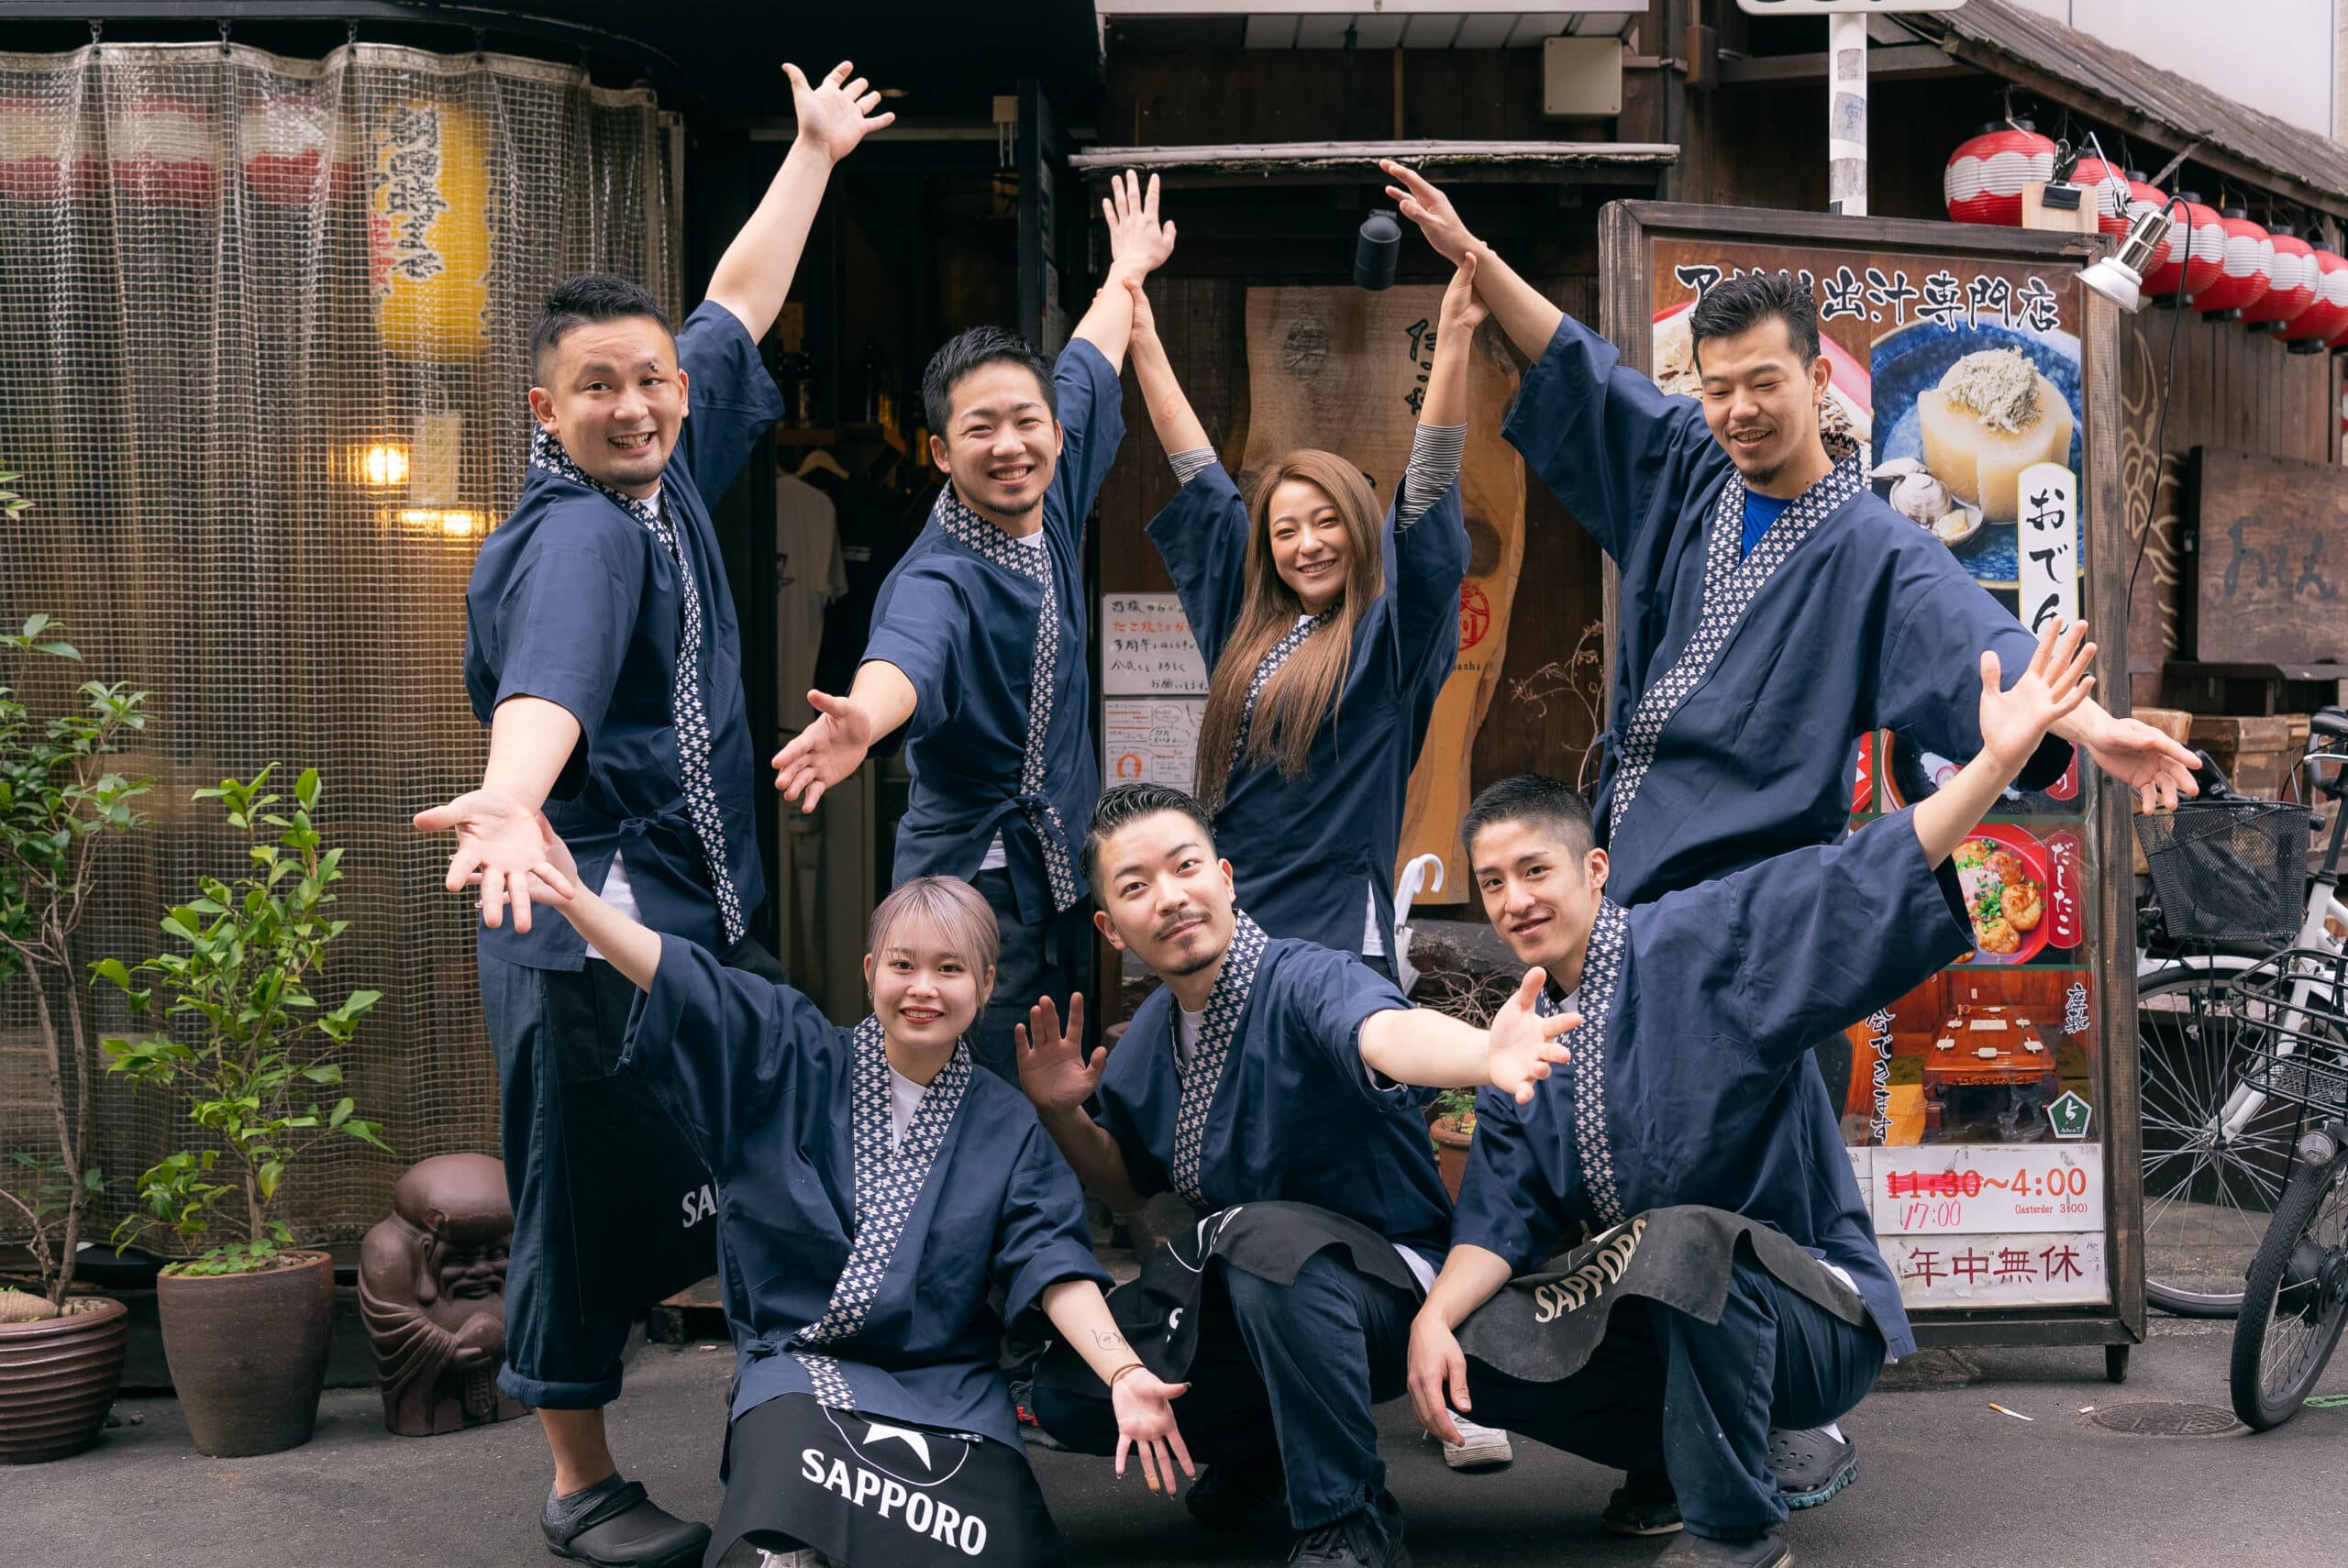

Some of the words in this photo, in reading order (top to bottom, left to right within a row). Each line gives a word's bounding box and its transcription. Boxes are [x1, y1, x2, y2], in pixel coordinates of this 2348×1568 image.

[1675, 265, 2060, 333] ア出汁専門店
[2025, 488, 2068, 635] おでん
[2051, 842, 2075, 935] だしたこ
[2065, 982, 2090, 1034] 座敷
[1902, 1199, 1962, 1231] 17:00
[1903, 1244, 2084, 1288] 年中無休
[801, 1448, 988, 1556] SAPPORO
